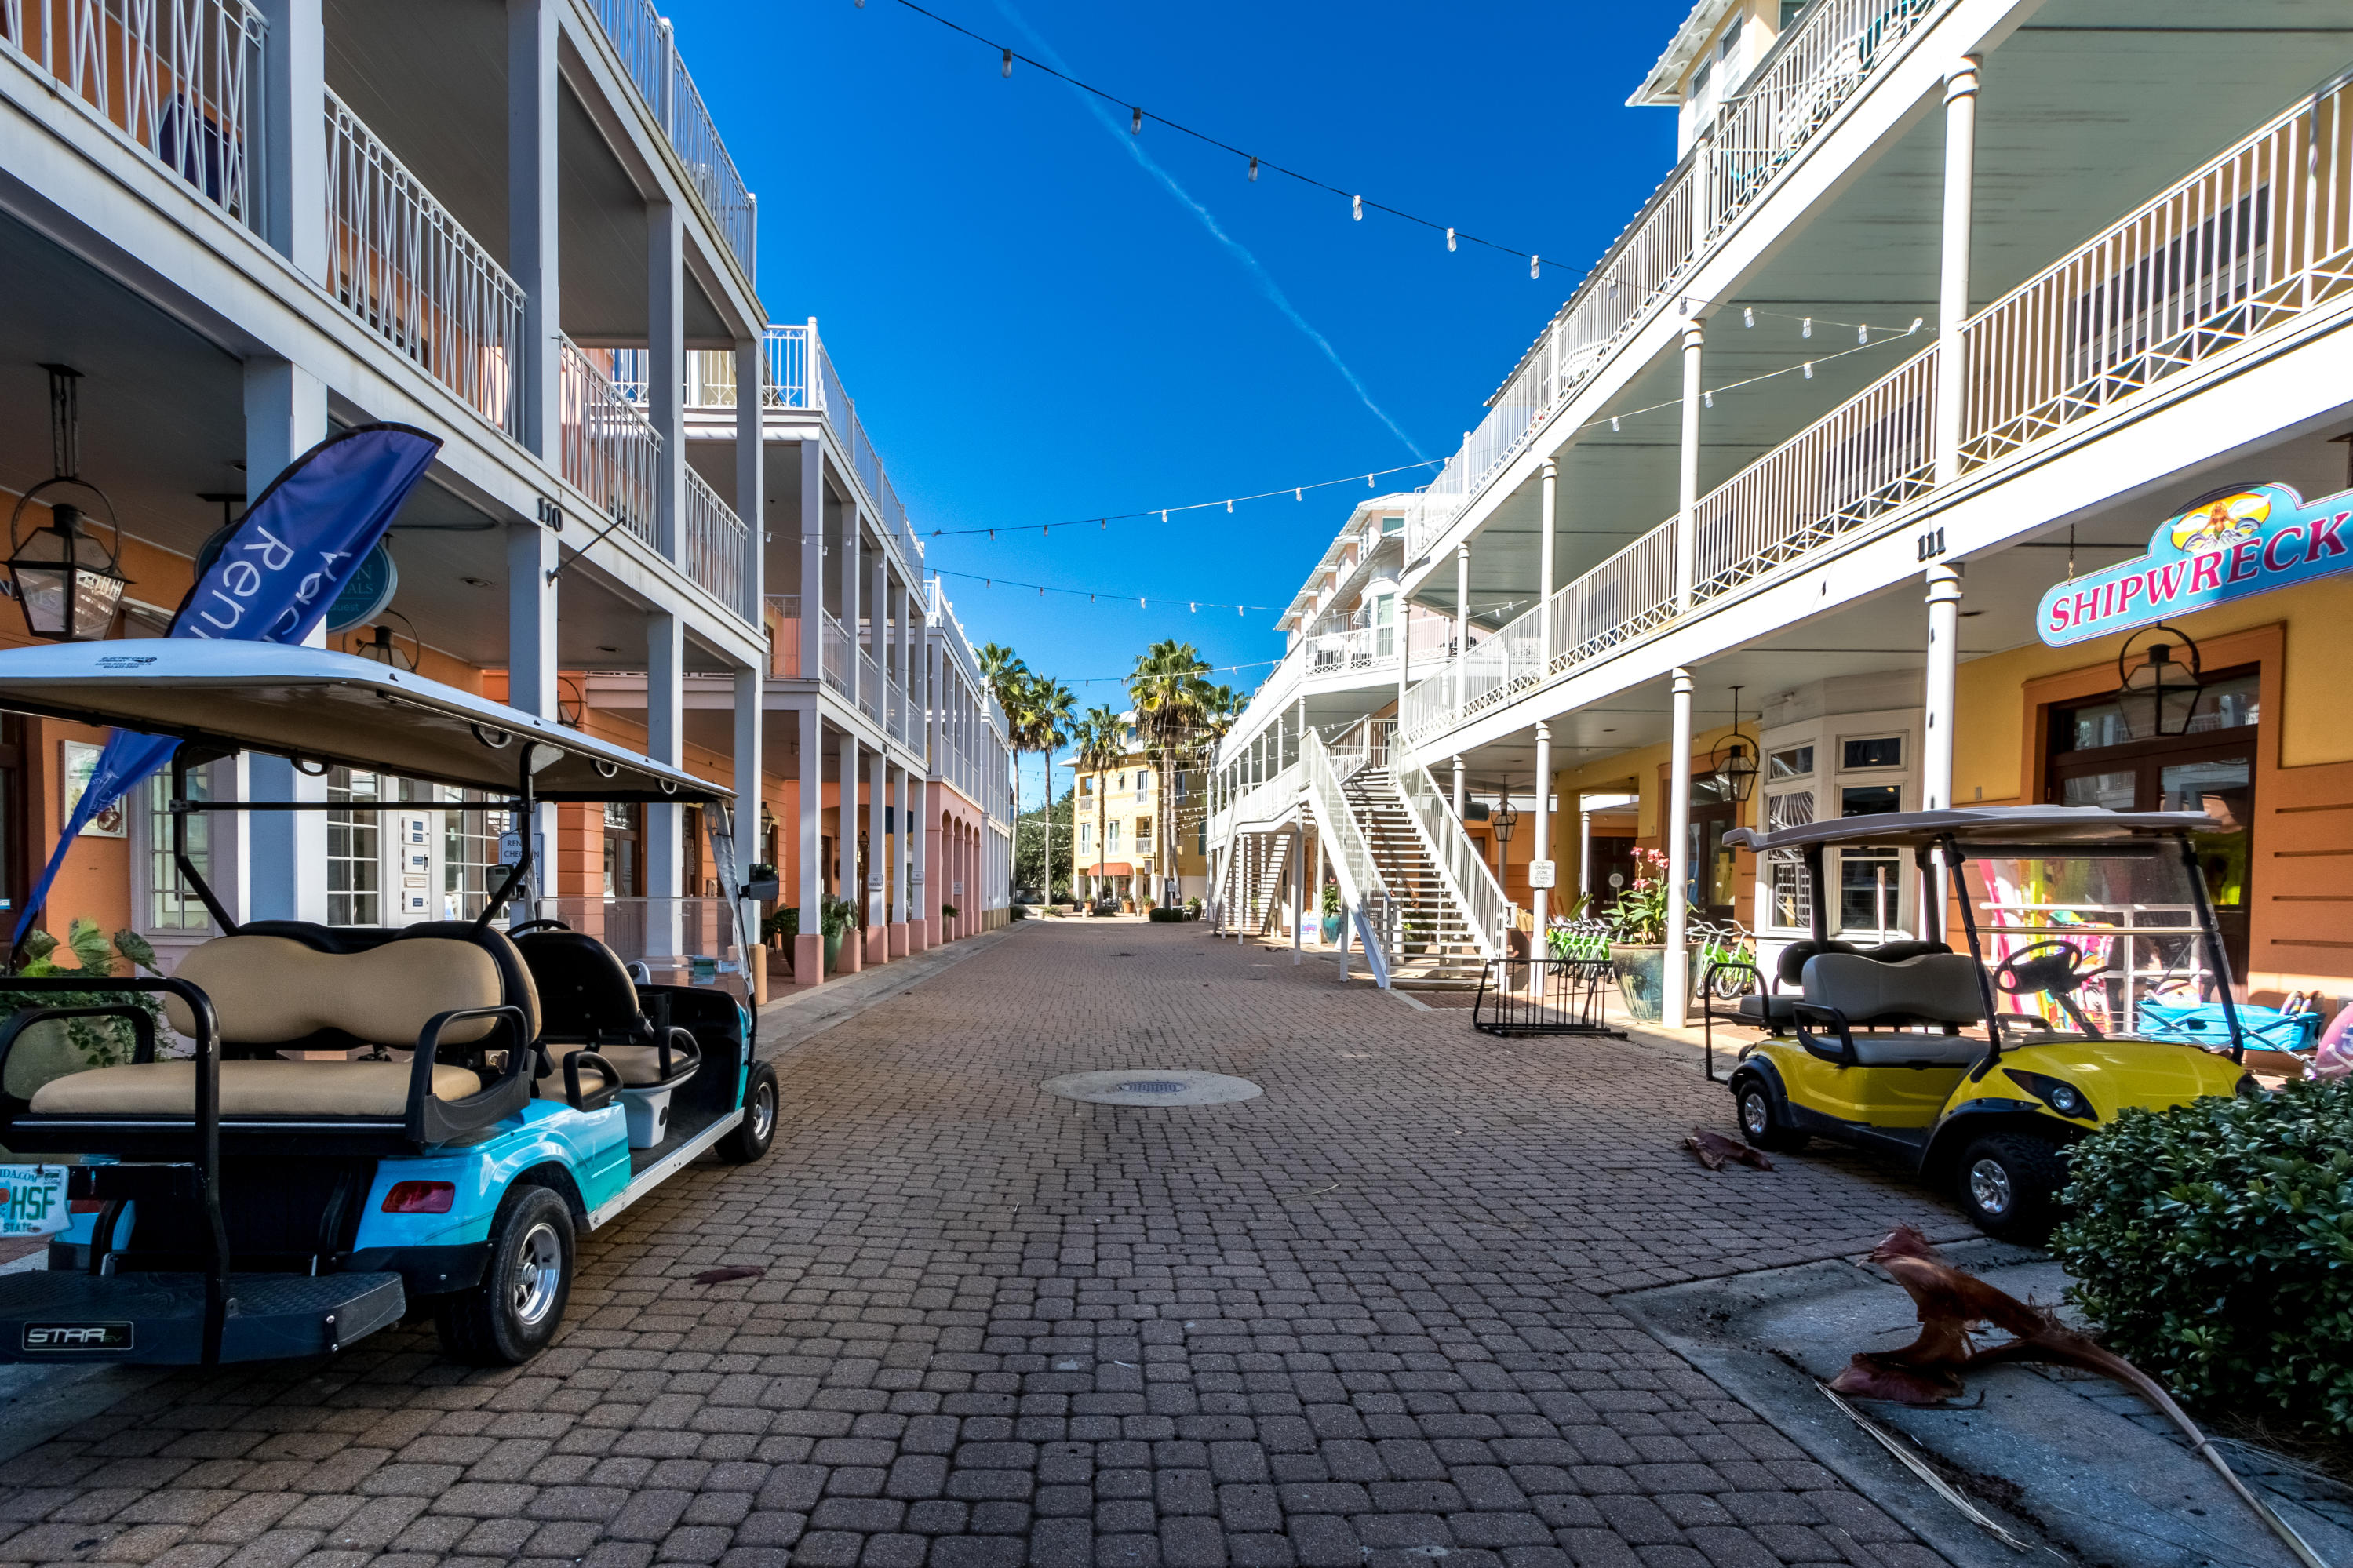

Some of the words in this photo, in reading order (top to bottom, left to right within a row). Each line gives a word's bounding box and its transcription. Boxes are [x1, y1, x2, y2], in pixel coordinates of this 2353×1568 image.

[537, 497, 563, 532] 110
[1917, 526, 1946, 562] 111
[2049, 511, 2350, 633] SHIPWRECK
[9, 1185, 58, 1220] HSF
[27, 1327, 107, 1343] STAR
